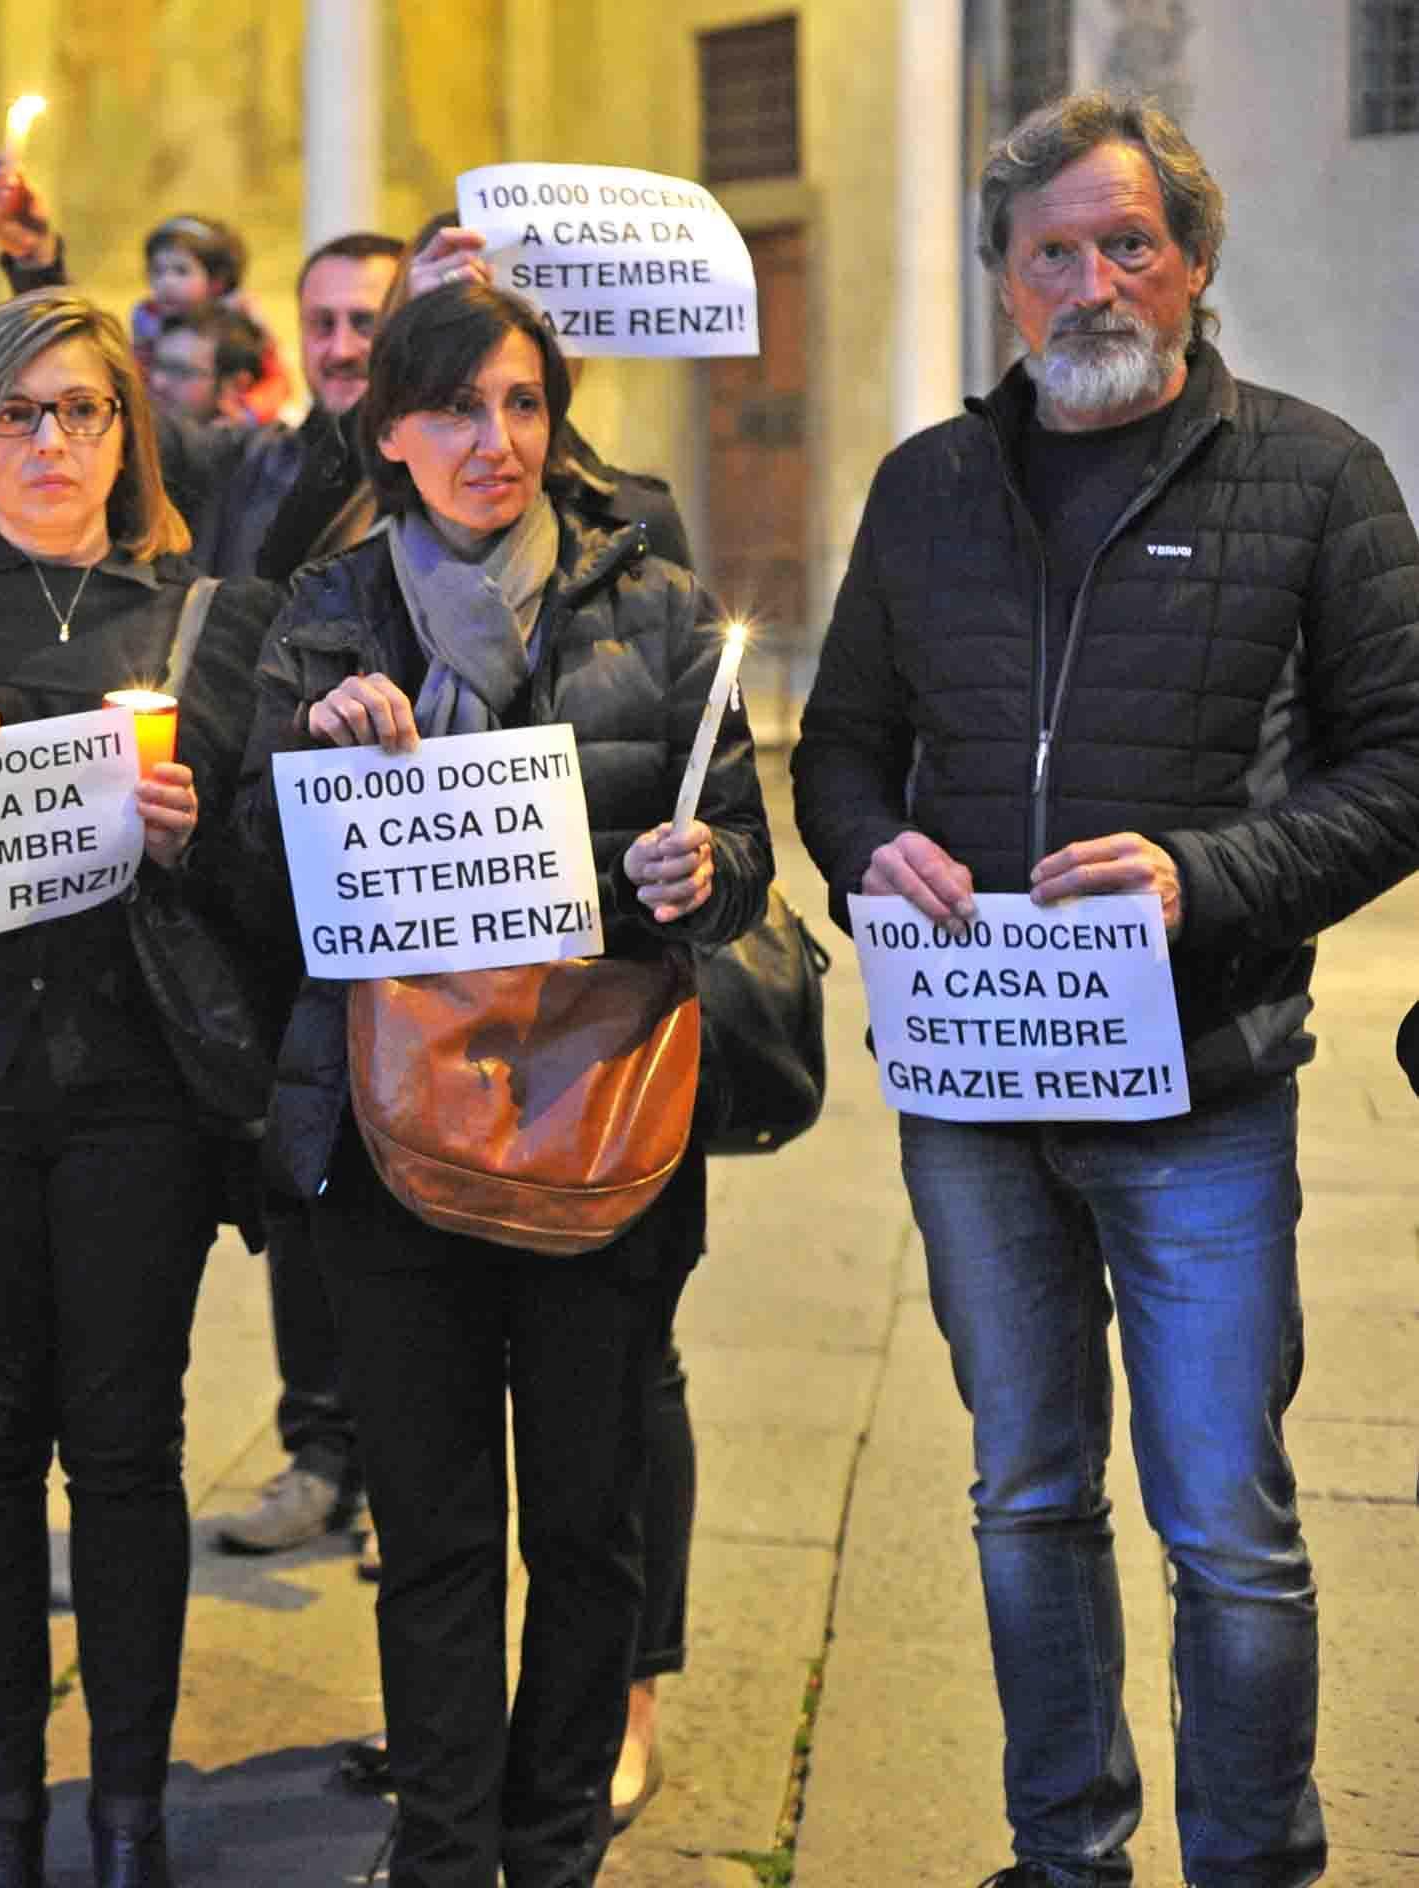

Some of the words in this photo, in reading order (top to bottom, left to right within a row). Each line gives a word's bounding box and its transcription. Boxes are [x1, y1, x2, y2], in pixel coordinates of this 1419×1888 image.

[477, 183, 589, 209] 100.000
[521, 224, 542, 246] A
[553, 221, 641, 246] CASA
[652, 222, 694, 243] DA
[511, 259, 711, 289] SETTEMBRE
[630, 304, 746, 336] RENZI!
[295, 768, 425, 805] 100.000
[438, 753, 571, 791] DOCENTI
[36, 783, 84, 814] DA
[343, 822, 367, 851] A
[379, 811, 483, 846] CASA
[495, 804, 543, 834] DA
[9, 861, 129, 911] RENZI!
[336, 851, 559, 900] SETTEMBRE
[312, 916, 459, 956] GRAZIE
[472, 900, 593, 943] RENZI!
[1003, 923, 1148, 950] DOCENTI
[911, 970, 933, 998] A
[944, 970, 1047, 998] CASA
[1058, 970, 1109, 999] DA
[906, 1016, 1127, 1048] SETTEMBRE
[887, 1060, 1022, 1099] GRAZIE
[1035, 1066, 1171, 1099] RENZI!
